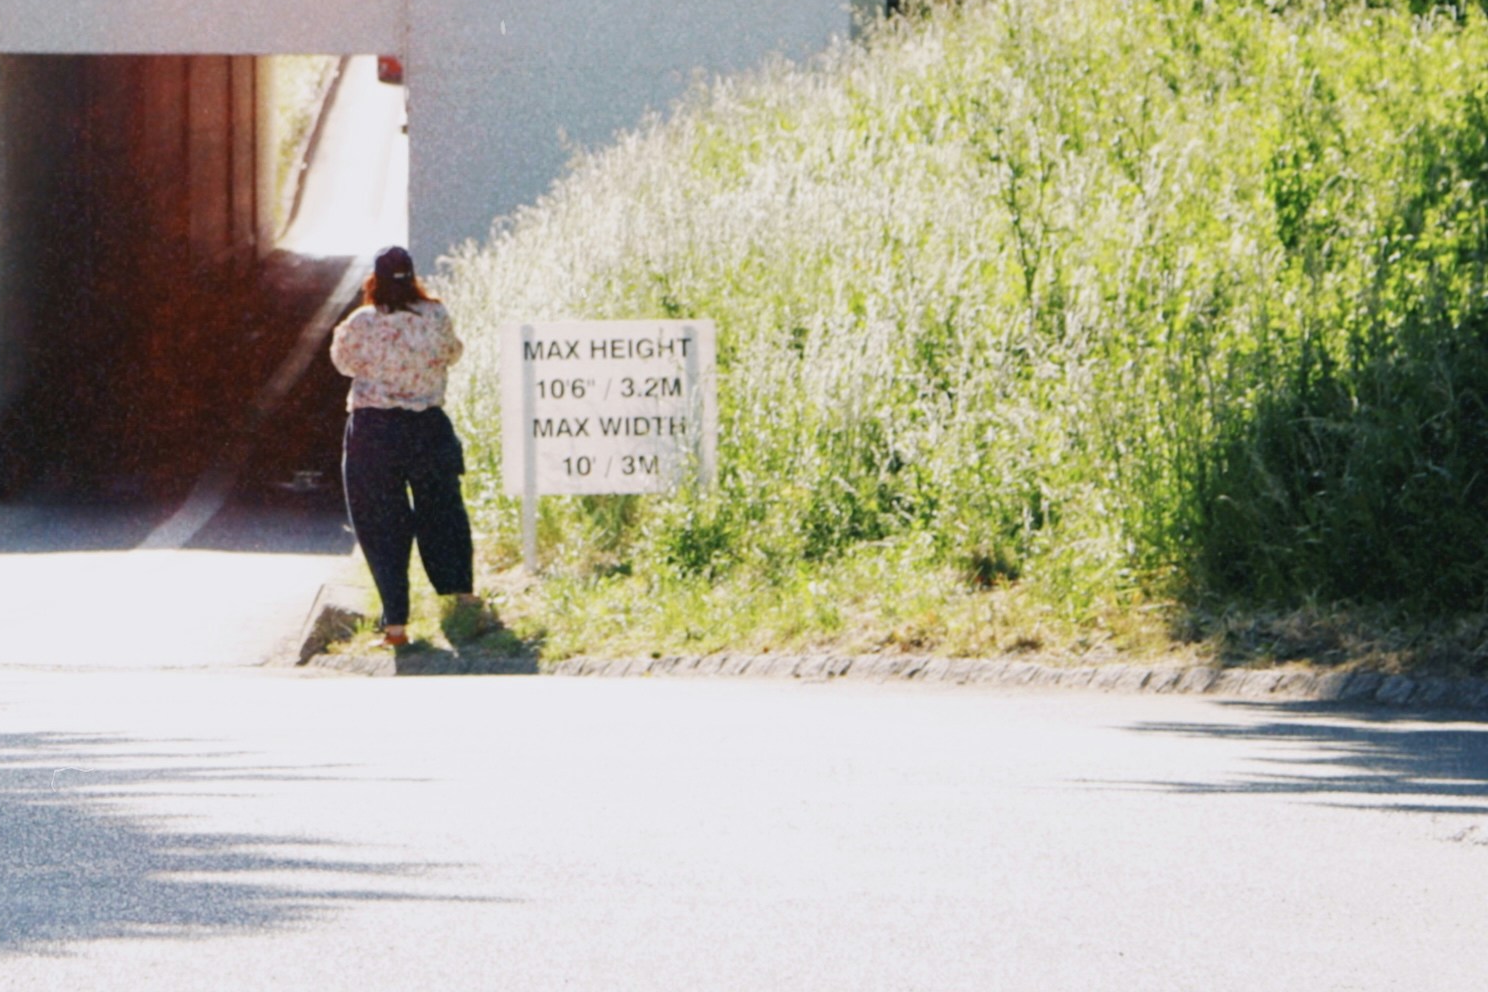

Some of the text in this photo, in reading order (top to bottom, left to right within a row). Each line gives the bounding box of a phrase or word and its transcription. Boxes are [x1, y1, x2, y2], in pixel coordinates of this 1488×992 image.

[523, 338, 692, 360] MAX HEIGHT
[603, 379, 613, 400] /
[620, 377, 682, 398] 3.2M
[532, 416, 687, 438] MAX WIDTH
[605, 456, 613, 478] /
[621, 455, 660, 475] 3M
